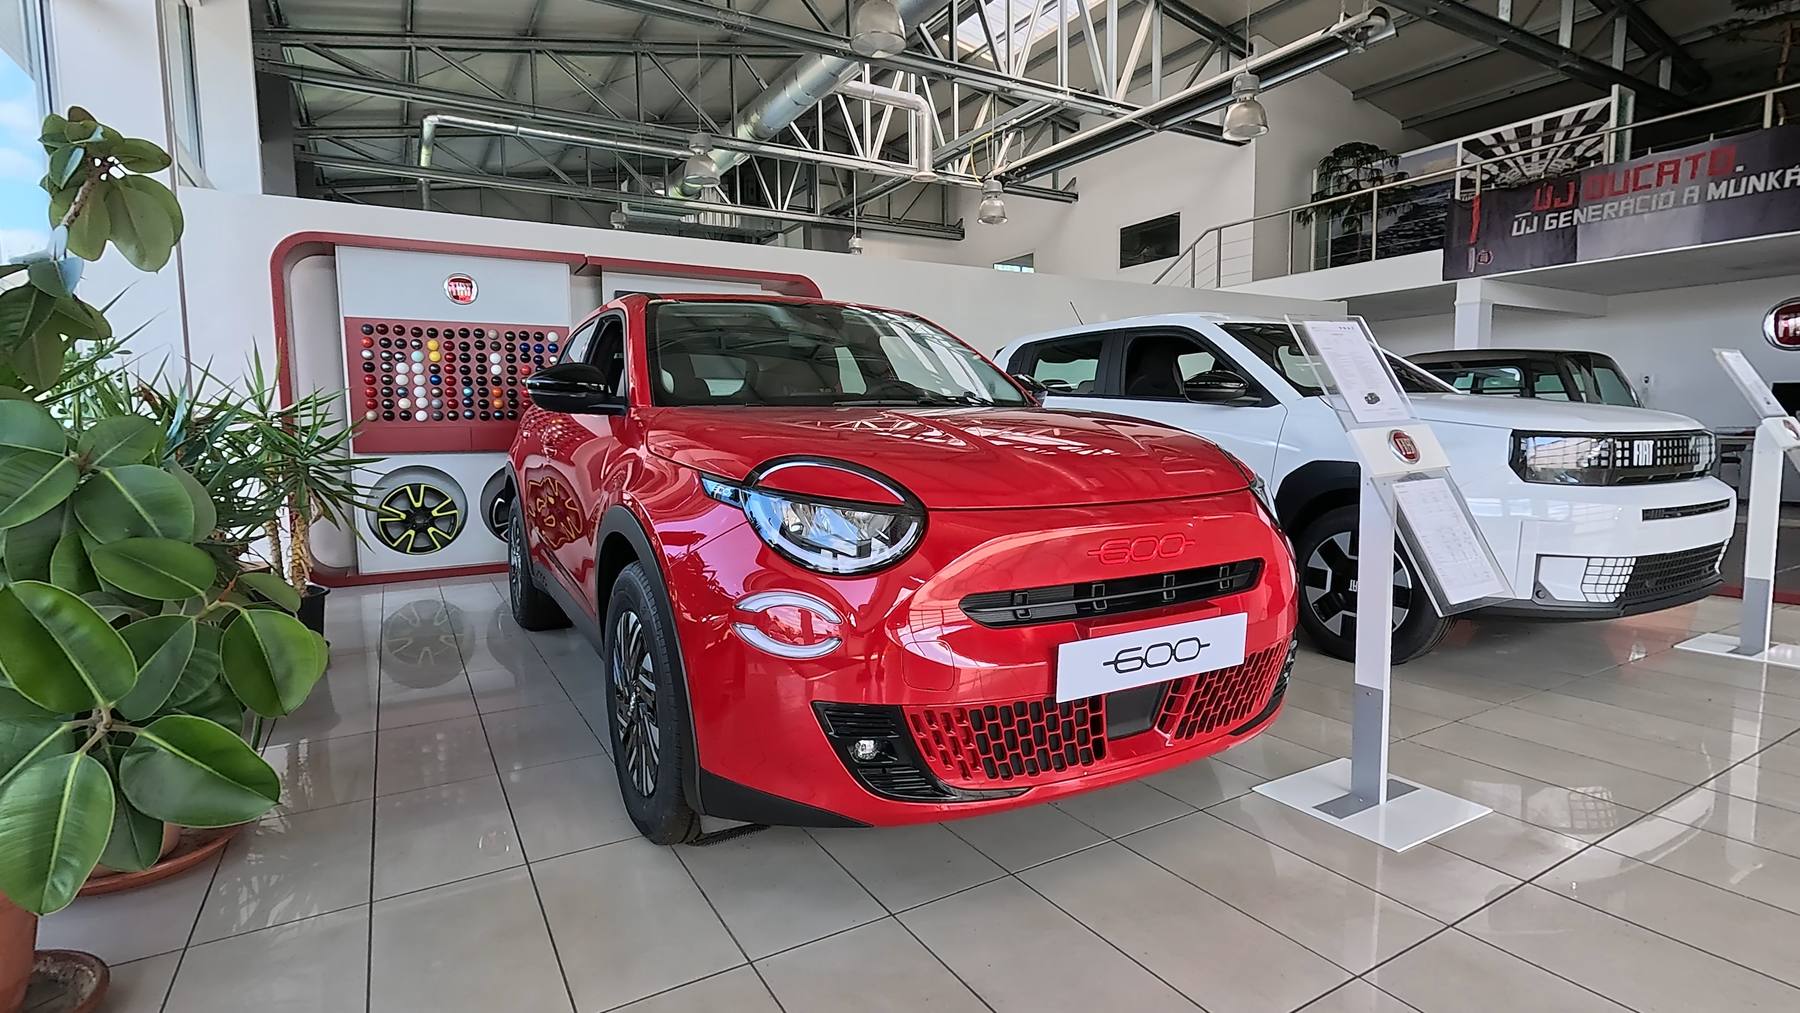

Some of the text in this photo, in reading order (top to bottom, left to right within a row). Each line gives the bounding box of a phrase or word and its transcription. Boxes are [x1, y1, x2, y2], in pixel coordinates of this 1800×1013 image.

[1582, 144, 1744, 202] DUCATO.
[1683, 185, 1700, 206] A
[1633, 440, 1654, 466] FIAT
[1097, 533, 1189, 565] 600
[1110, 636, 1204, 674] 600
